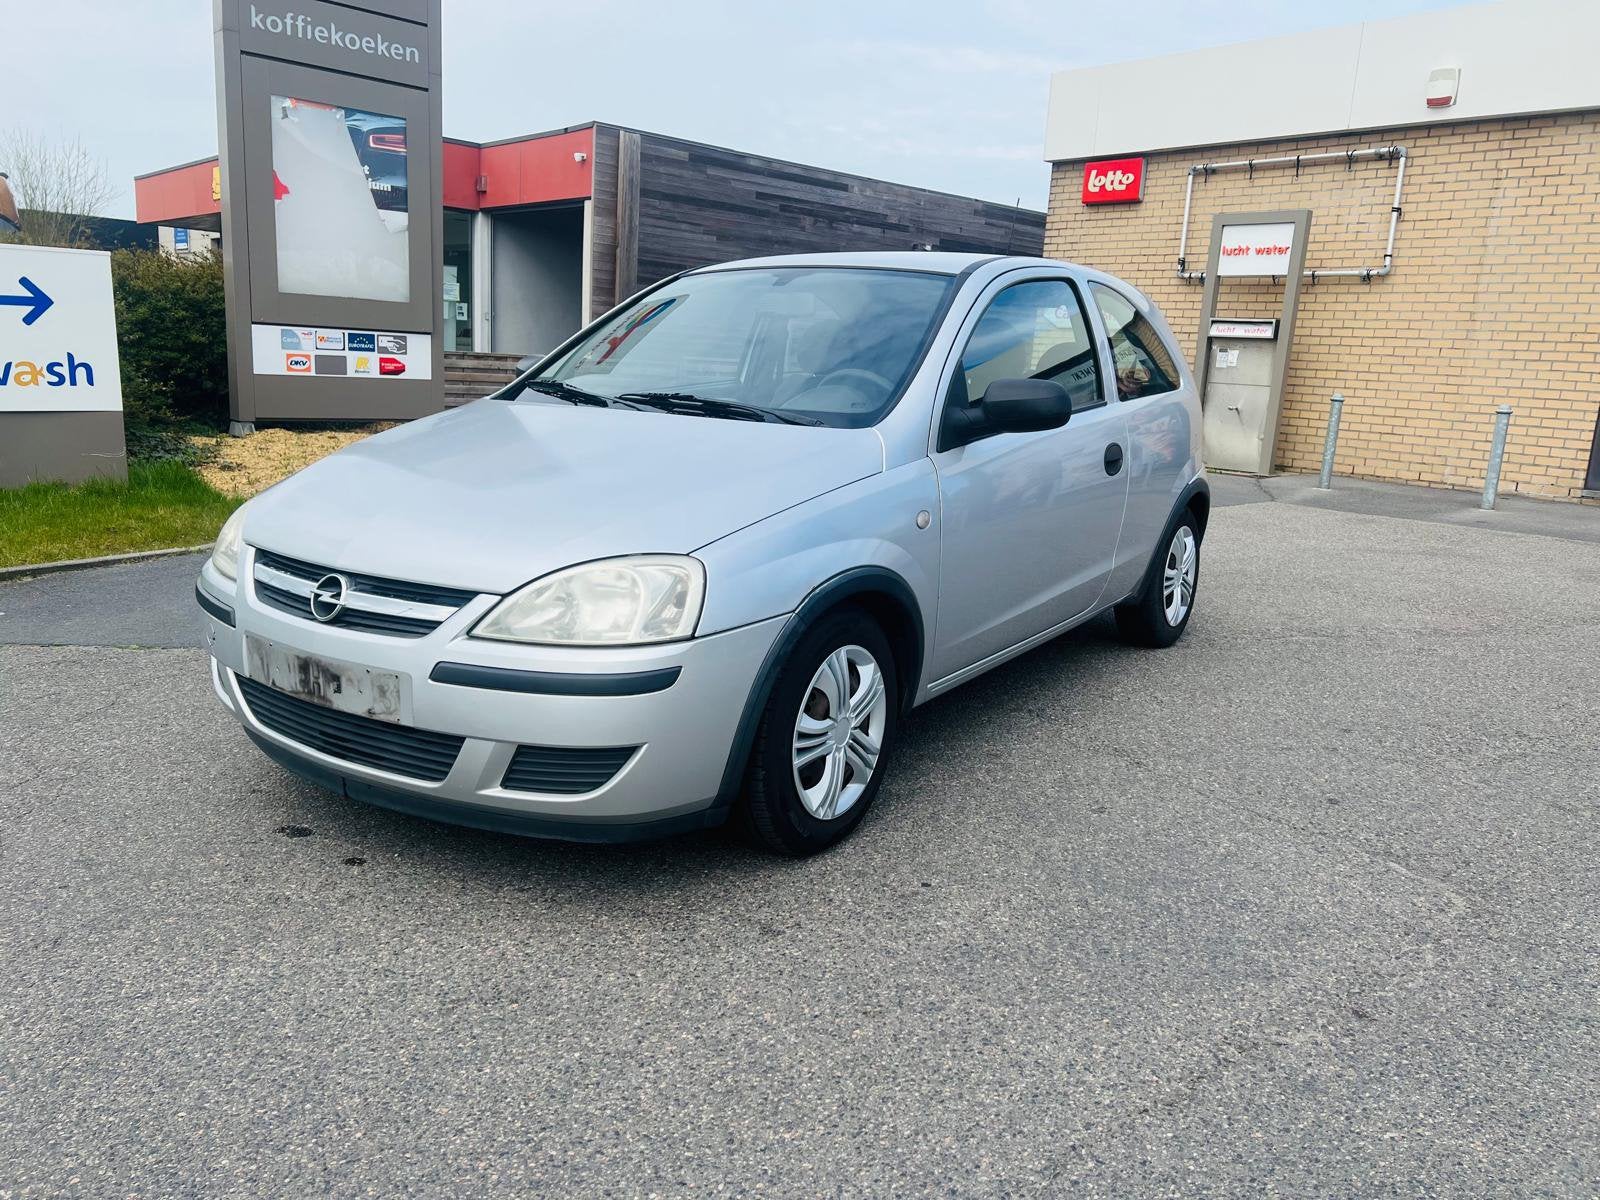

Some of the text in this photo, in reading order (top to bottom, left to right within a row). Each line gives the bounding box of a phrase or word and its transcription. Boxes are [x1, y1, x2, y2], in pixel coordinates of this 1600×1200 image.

[250, 4, 420, 64] koffiekoeken
[1221, 244, 1290, 256] lucht water
[1215, 326, 1269, 335] lucht water
